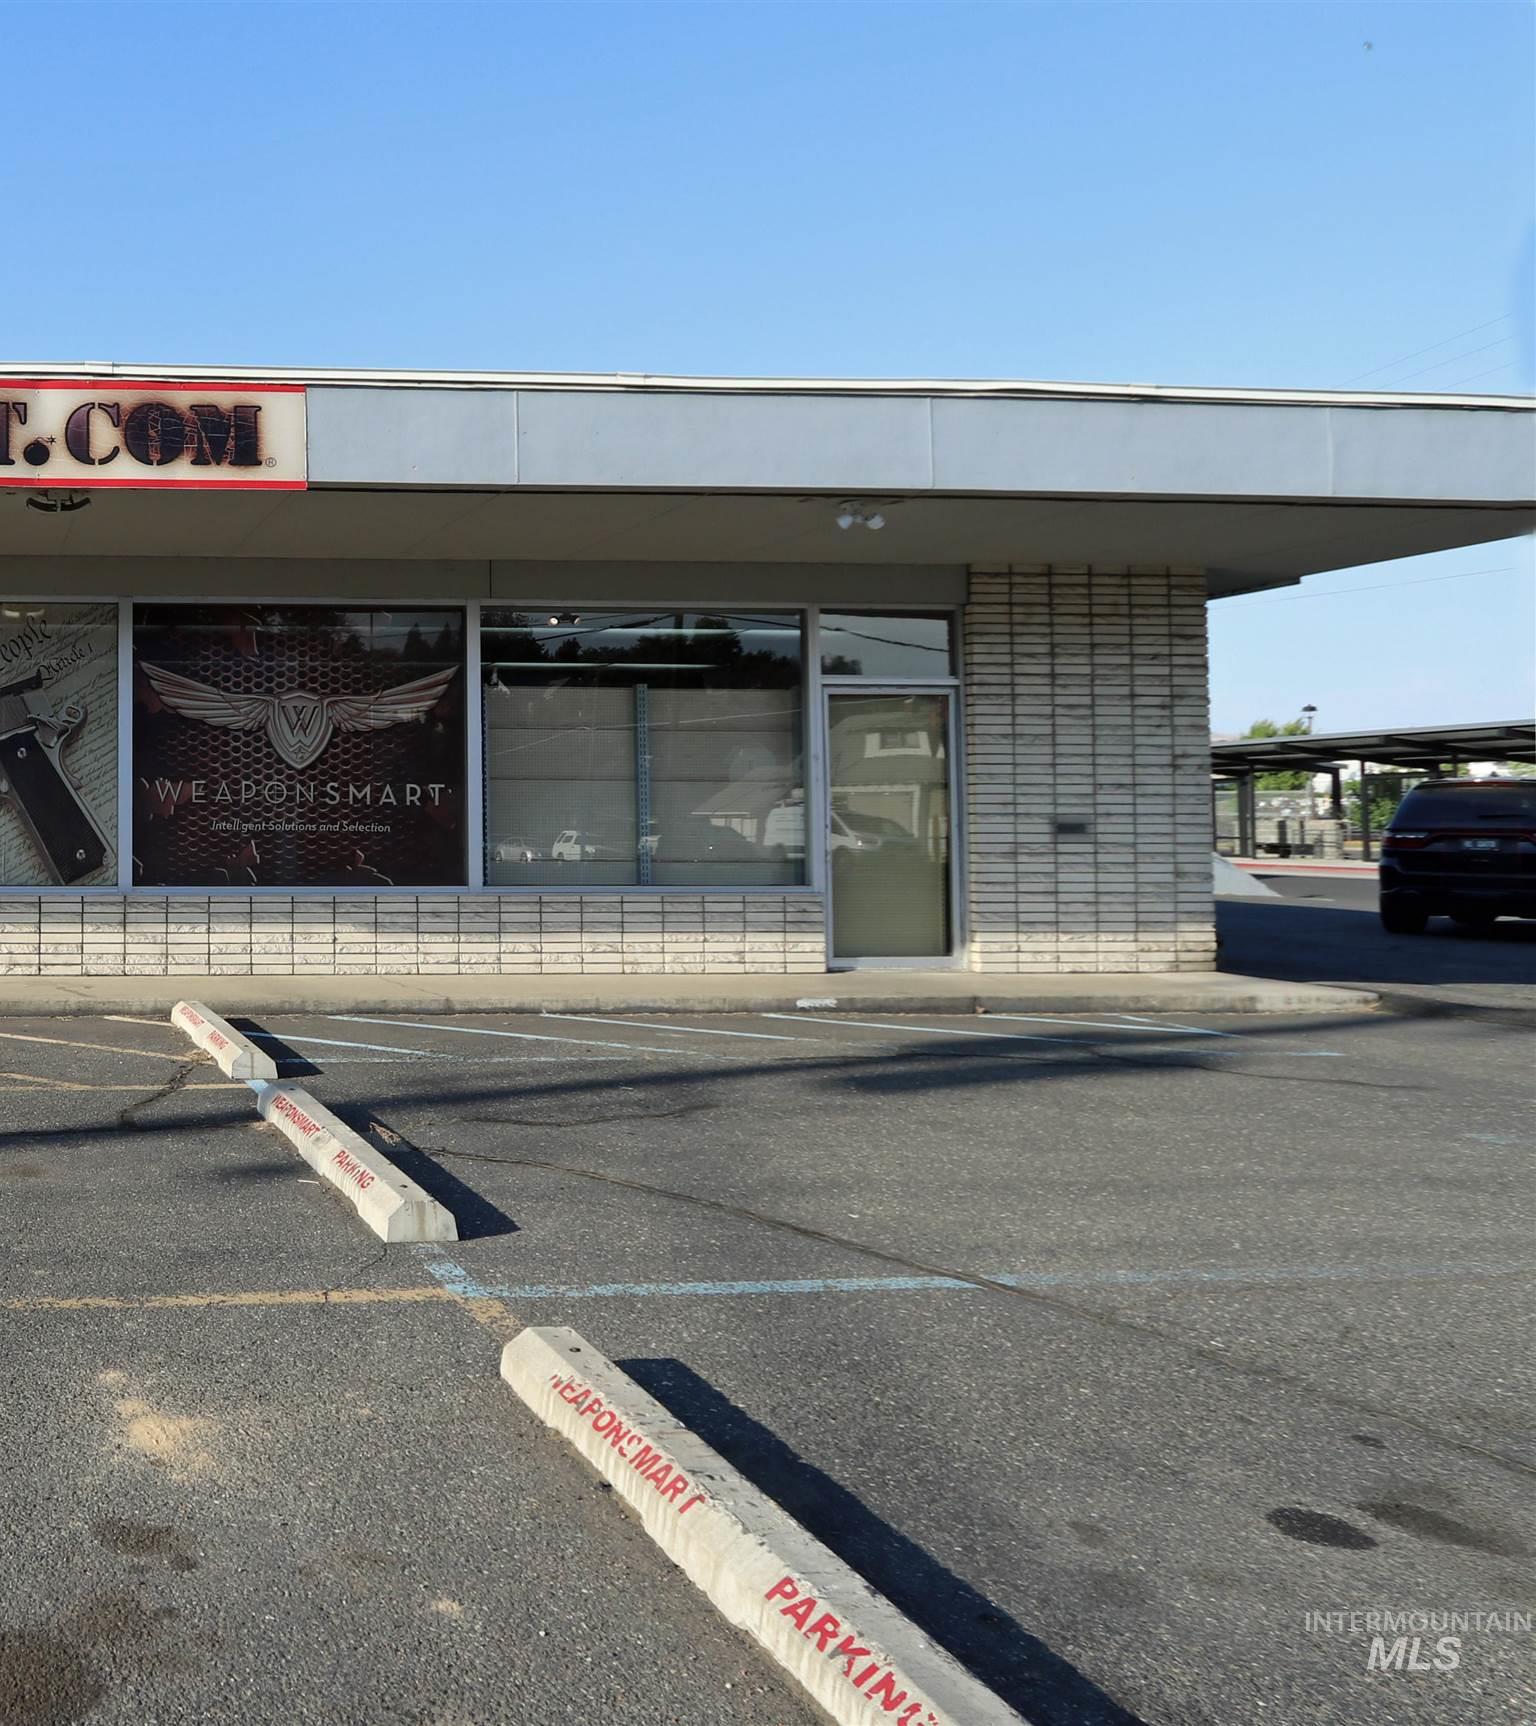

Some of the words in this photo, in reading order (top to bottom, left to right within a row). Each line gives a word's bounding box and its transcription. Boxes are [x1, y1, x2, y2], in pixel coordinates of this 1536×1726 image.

[155, 780, 445, 806] WEAPONSMART
[211, 820, 266, 834] Intelligent
[268, 820, 317, 832] Solutions
[319, 821, 340, 832] and
[342, 821, 391, 833] Selection
[271, 1094, 321, 1138] WEAPONSMART
[332, 1150, 375, 1189] PARKING
